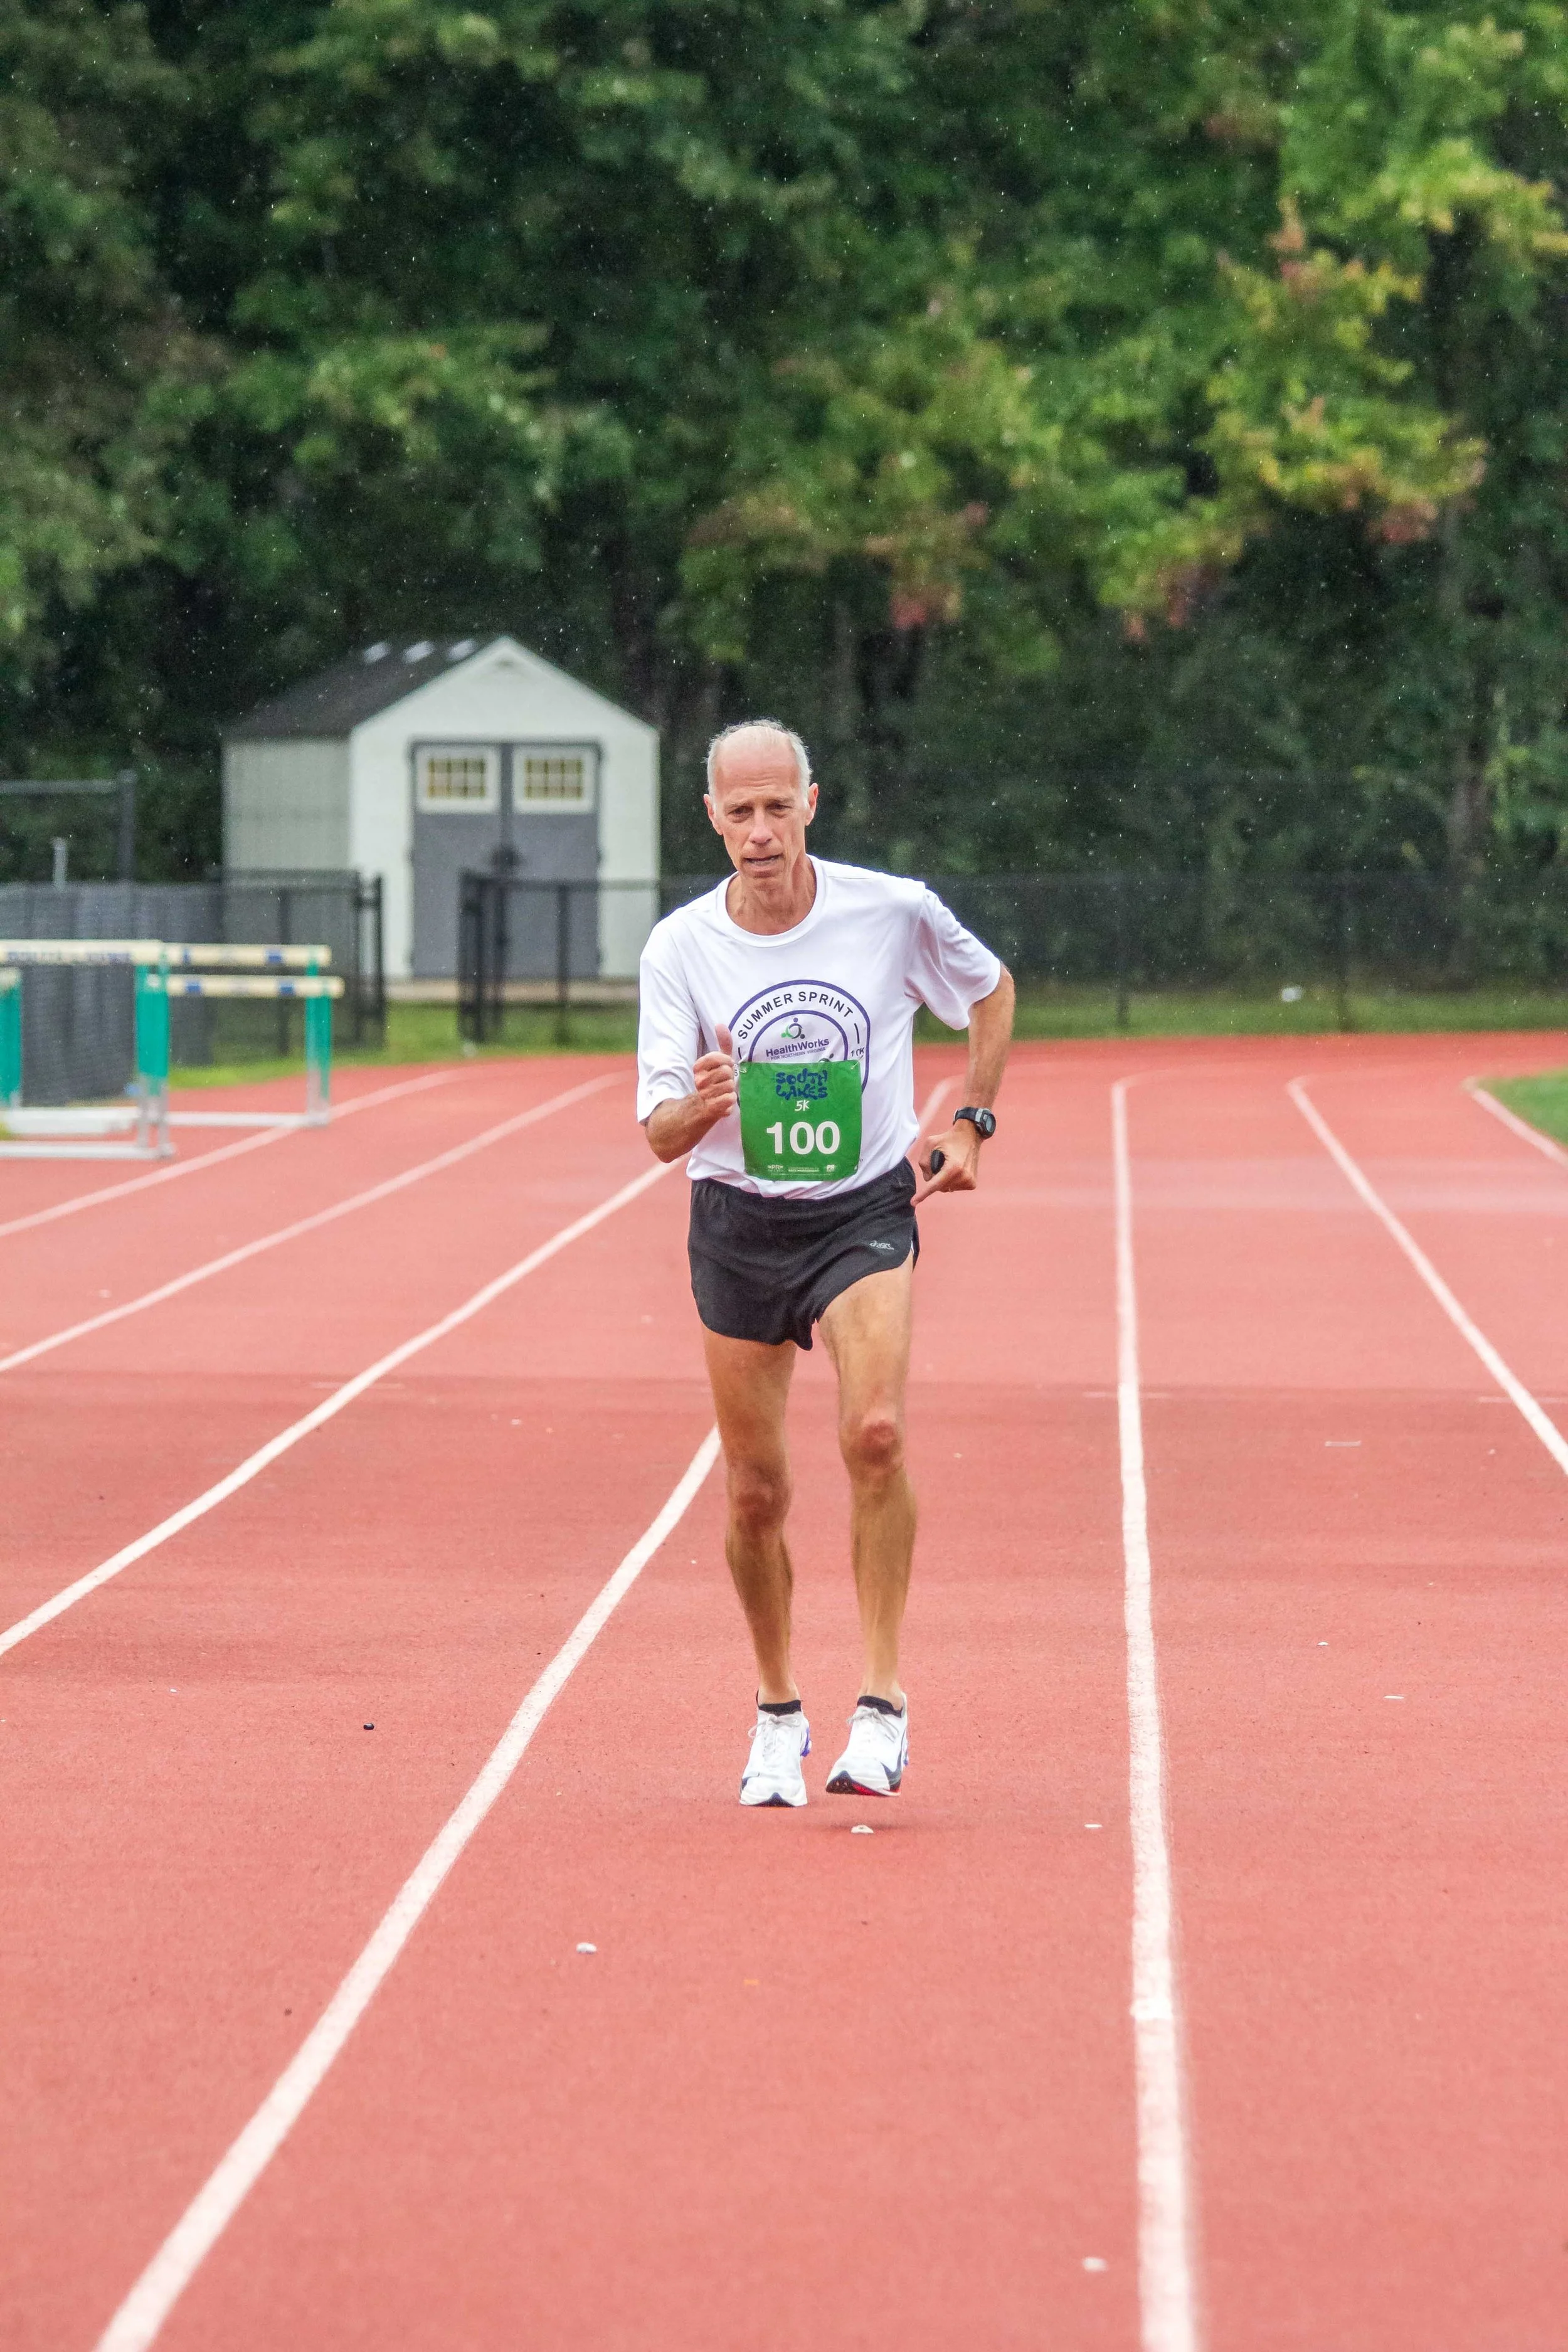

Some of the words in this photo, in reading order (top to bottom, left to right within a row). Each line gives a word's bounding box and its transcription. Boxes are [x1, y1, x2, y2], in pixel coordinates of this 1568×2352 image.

[738, 993, 793, 1039] SUMMER
[798, 992, 853, 1017] SPRINT
[766, 1039, 829, 1057] HealthWorks
[776, 1068, 827, 1086] SOUTH
[776, 1084, 828, 1101] LAKES
[794, 1100, 810, 1111] 5K
[766, 1121, 840, 1155] 100
